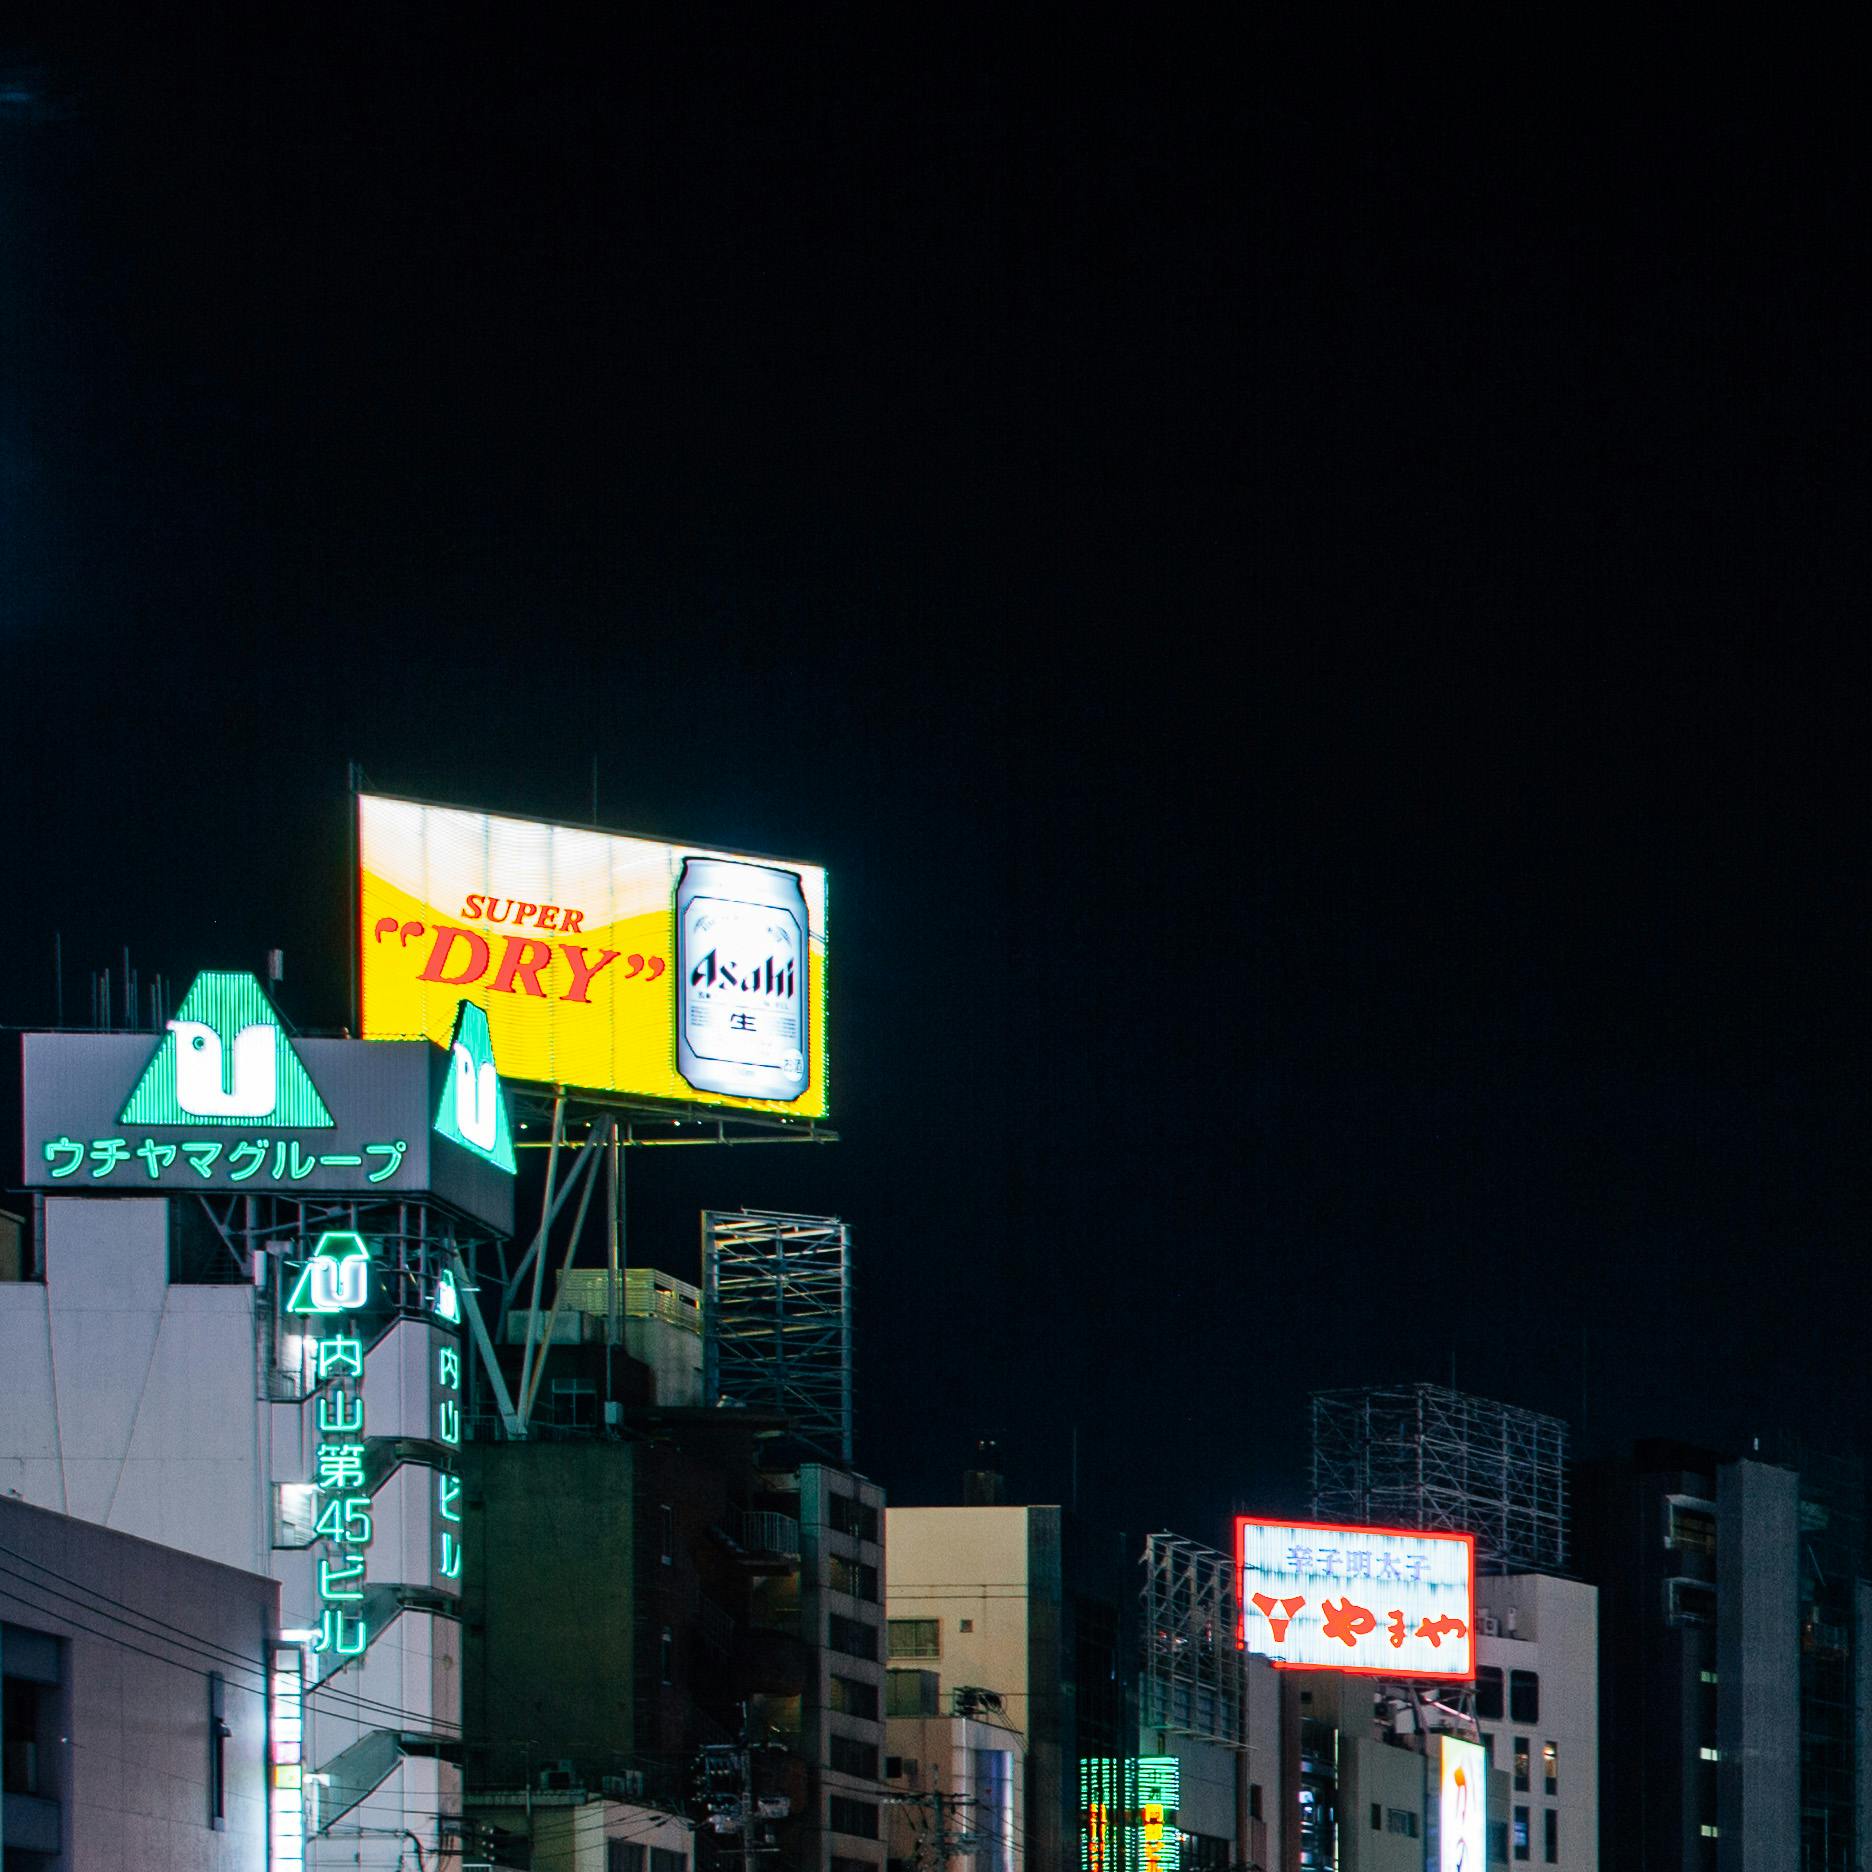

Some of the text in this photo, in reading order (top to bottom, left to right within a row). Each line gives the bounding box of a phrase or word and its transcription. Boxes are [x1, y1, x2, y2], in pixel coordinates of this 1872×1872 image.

[461, 893, 584, 933] SUPER
[690, 948, 795, 999] Asahi
[730, 1012, 757, 1032] 生
[44, 1136, 409, 1183] ウチヤマグループ
[315, 1333, 371, 1655] 内山第45ビル
[1321, 1596, 1468, 1649] やまや
